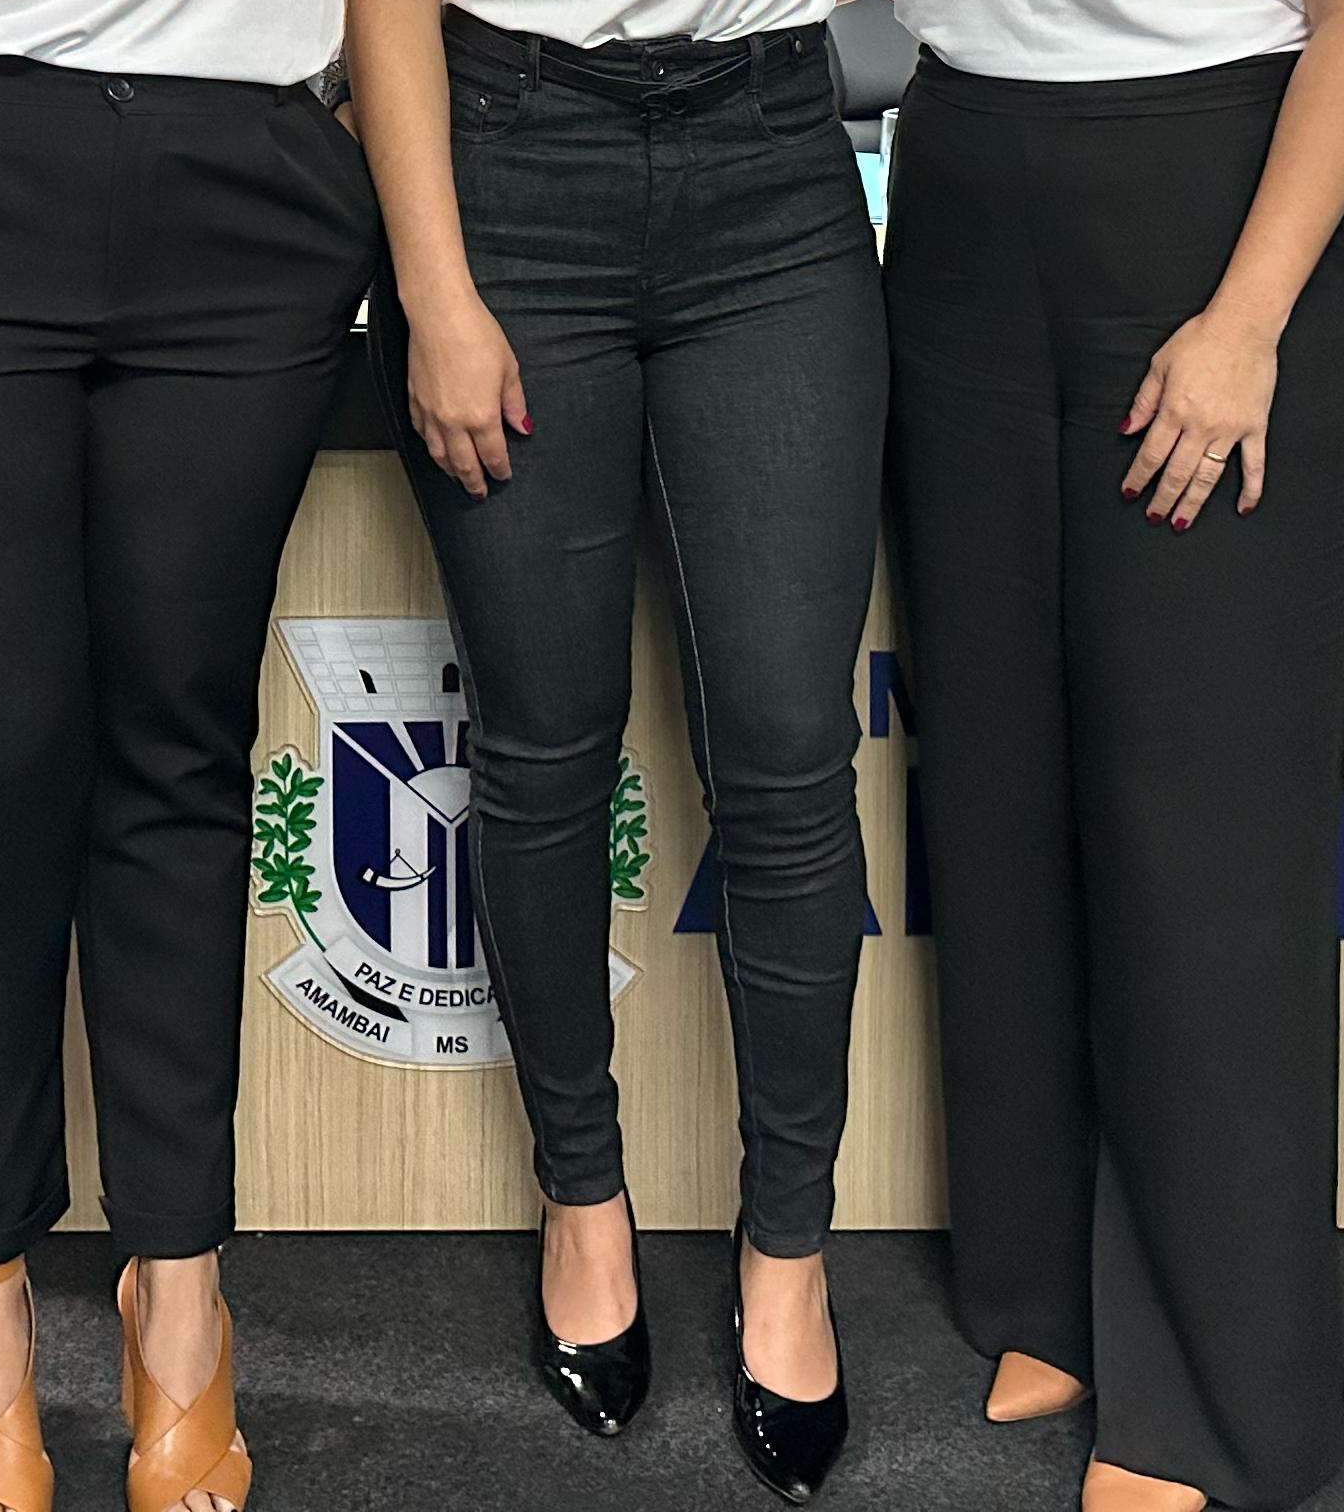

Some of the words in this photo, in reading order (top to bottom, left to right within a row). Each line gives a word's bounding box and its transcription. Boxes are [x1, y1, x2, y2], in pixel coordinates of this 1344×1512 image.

[354, 962, 396, 995] PAZ
[398, 983, 415, 1002] E
[296, 977, 391, 1043] AMAMBAI
[435, 1036, 469, 1054] MS
